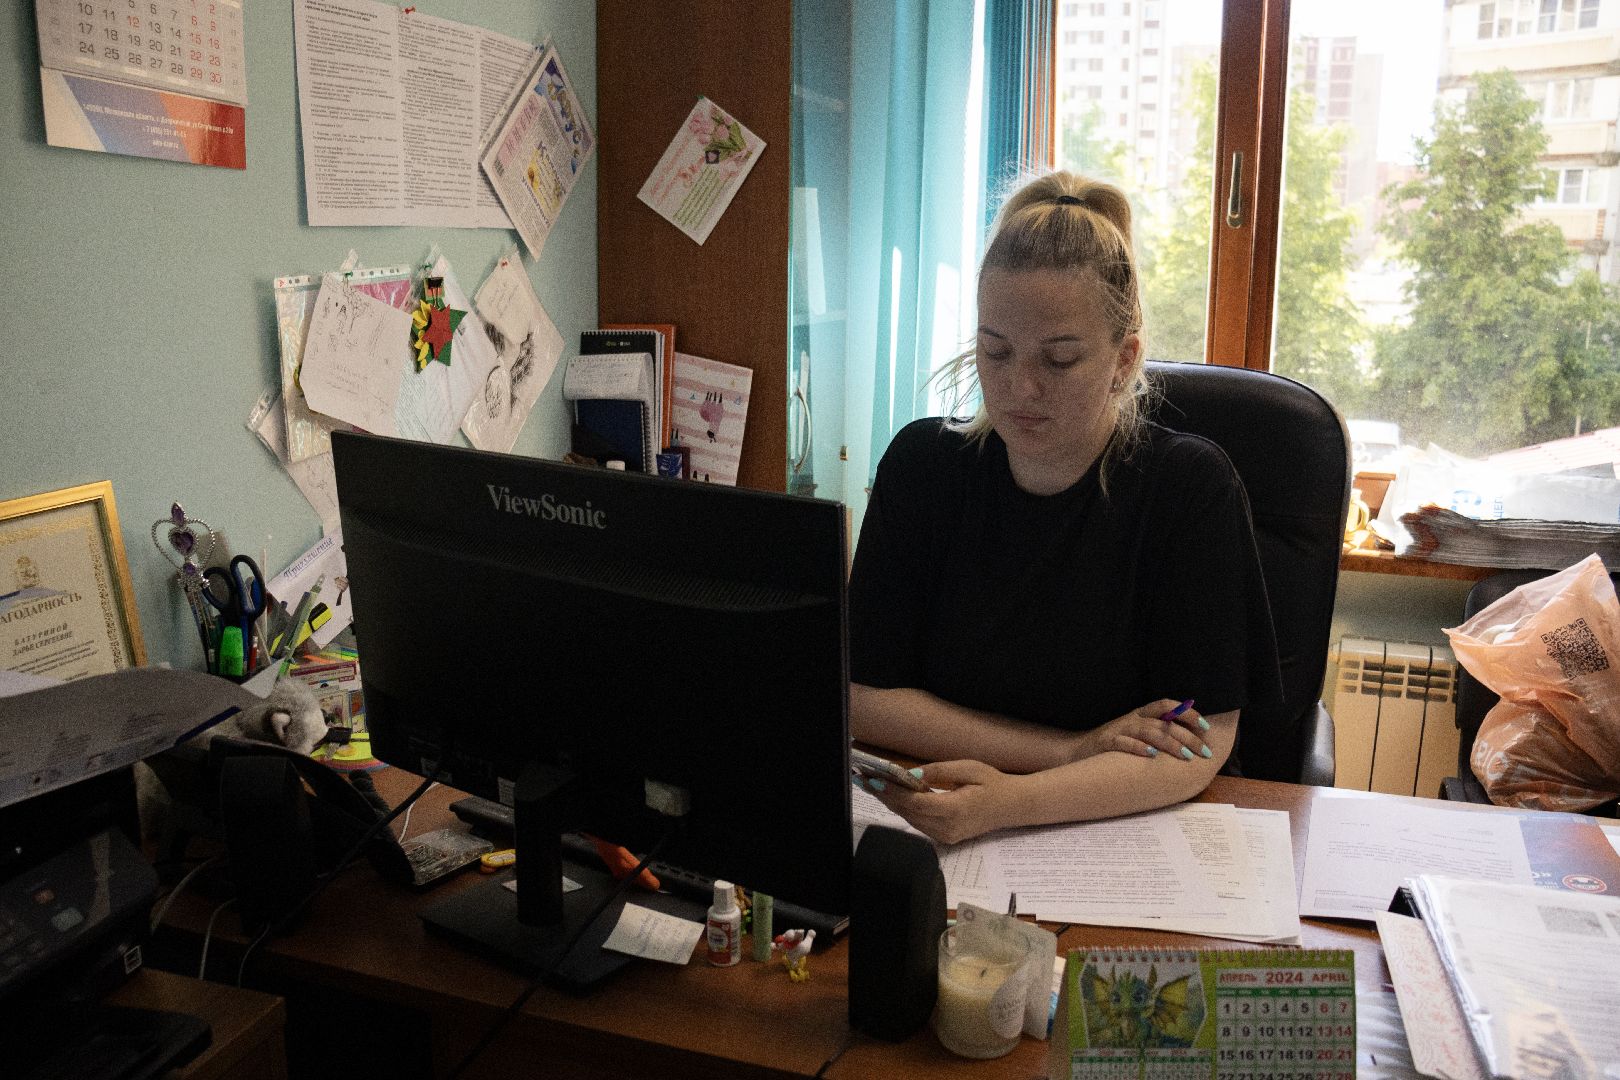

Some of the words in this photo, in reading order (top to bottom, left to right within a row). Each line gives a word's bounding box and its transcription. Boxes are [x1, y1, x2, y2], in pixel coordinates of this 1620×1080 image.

[151, 4, 157, 14] 6
[170, 10, 177, 20] 7
[210, 5, 215, 14] 2
[78, 3, 92, 15] 10
[103, 9, 115, 20] 11
[127, 15, 139, 28] 12
[149, 21, 161, 34] 13
[170, 27, 181, 39] 14
[190, 33, 201, 44] 15
[209, 38, 220, 49] 16
[79, 23, 92, 35] 17
[104, 28, 118, 41] 18
[128, 34, 140, 46] 19
[149, 40, 162, 52] 20
[170, 44, 182, 57] 21
[190, 50, 202, 62] 22
[209, 55, 220, 67] 23
[80, 41, 95, 55] 24
[105, 48, 119, 60] 25
[128, 53, 142, 65] 26
[150, 58, 162, 70] 27
[171, 63, 183, 75] 28
[190, 68, 202, 79] 29
[209, 72, 222, 84] 30
[487, 484, 607, 529] ViewSonic
[1266, 971, 1304, 985] 2024
[1312, 973, 1349, 982] APRIL
[1224, 1003, 1230, 1013] 1
[1242, 1003, 1250, 1014] 2
[1262, 1003, 1269, 1013] 3
[1281, 1003, 1289, 1013] 4
[1301, 1002, 1309, 1013] 5
[1320, 1002, 1328, 1013] 6
[1339, 1002, 1347, 1013] 7
[1222, 1027, 1231, 1036] 8
[1242, 1025, 1251, 1036] 9
[1259, 1026, 1274, 1036] 10
[1280, 1026, 1293, 1036] 11
[1298, 1026, 1312, 1036] 12
[1318, 1026, 1333, 1036] 13
[1336, 1025, 1352, 1036] 14
[1220, 1050, 1235, 1060] 15
[1239, 1050, 1254, 1060] 16
[1259, 1050, 1273, 1060] 17
[1279, 1050, 1294, 1060] 18
[1299, 1050, 1313, 1060] 19
[1316, 1050, 1333, 1060] 20
[1338, 1050, 1352, 1060] 21
